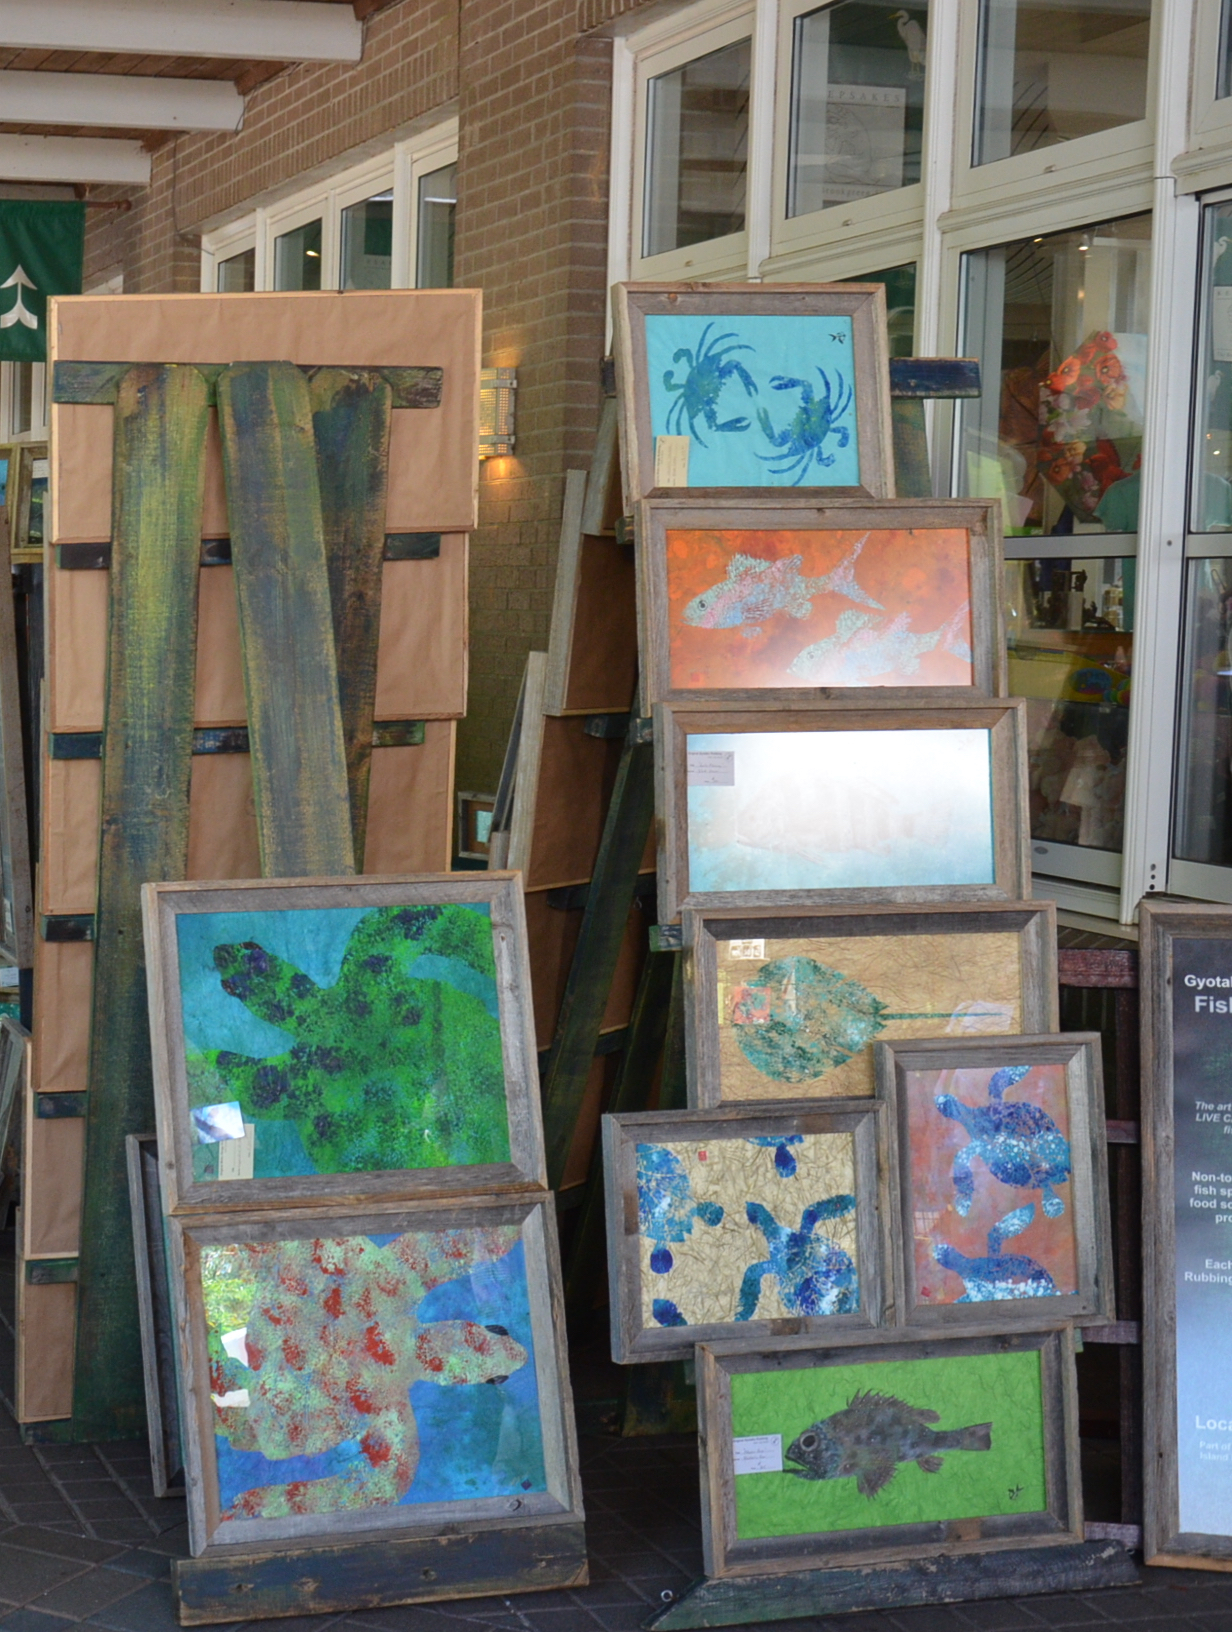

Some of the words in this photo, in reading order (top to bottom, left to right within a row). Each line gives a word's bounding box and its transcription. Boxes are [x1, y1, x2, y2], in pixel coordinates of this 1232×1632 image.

[1184, 974, 1232, 990] Gyota
[1195, 1101, 1215, 1110] The
[1217, 1103, 1232, 1111] art
[1196, 1113, 1221, 1122] LIVE
[1223, 1113, 1232, 1123] C
[1223, 1125, 1232, 1134] fi
[1191, 1171, 1232, 1183] Non-to
[1194, 1184, 1217, 1196] fish
[1189, 1198, 1217, 1209] food
[1184, 1271, 1232, 1286] Rubbing
[1199, 1441, 1218, 1449] Part
[1199, 1451, 1228, 1460] Island
